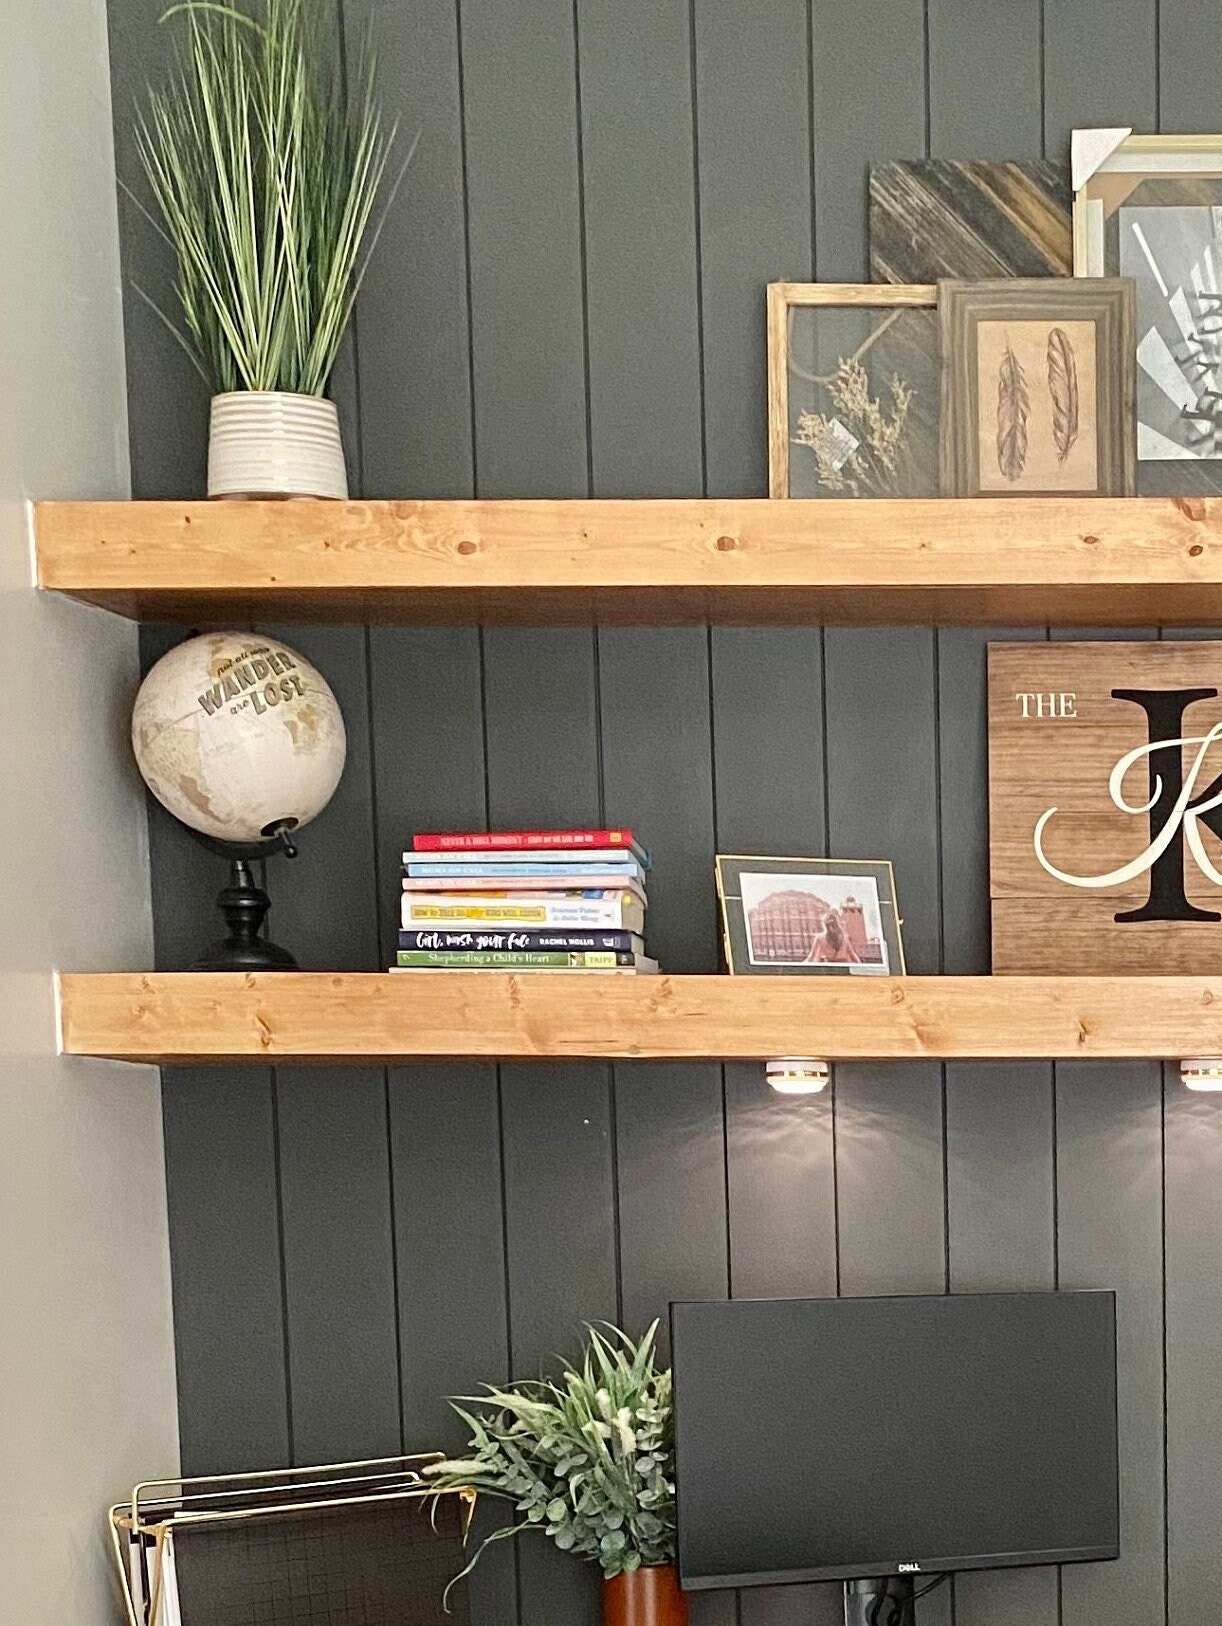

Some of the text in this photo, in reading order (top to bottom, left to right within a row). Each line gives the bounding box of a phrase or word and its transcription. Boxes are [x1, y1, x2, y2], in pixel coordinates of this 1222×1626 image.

[198, 652, 296, 716] WANDER
[230, 674, 305, 715] are LOST
[1015, 692, 1078, 719] THE
[446, 934, 473, 946] wash
[476, 935, 506, 950] your
[507, 932, 530, 949] face
[539, 938, 594, 946] RACHEL HOLLIS
[428, 953, 484, 965] Shepherding
[493, 953, 521, 963] Child's
[524, 953, 550, 963] Heart
[898, 1562, 921, 1572] DELL
